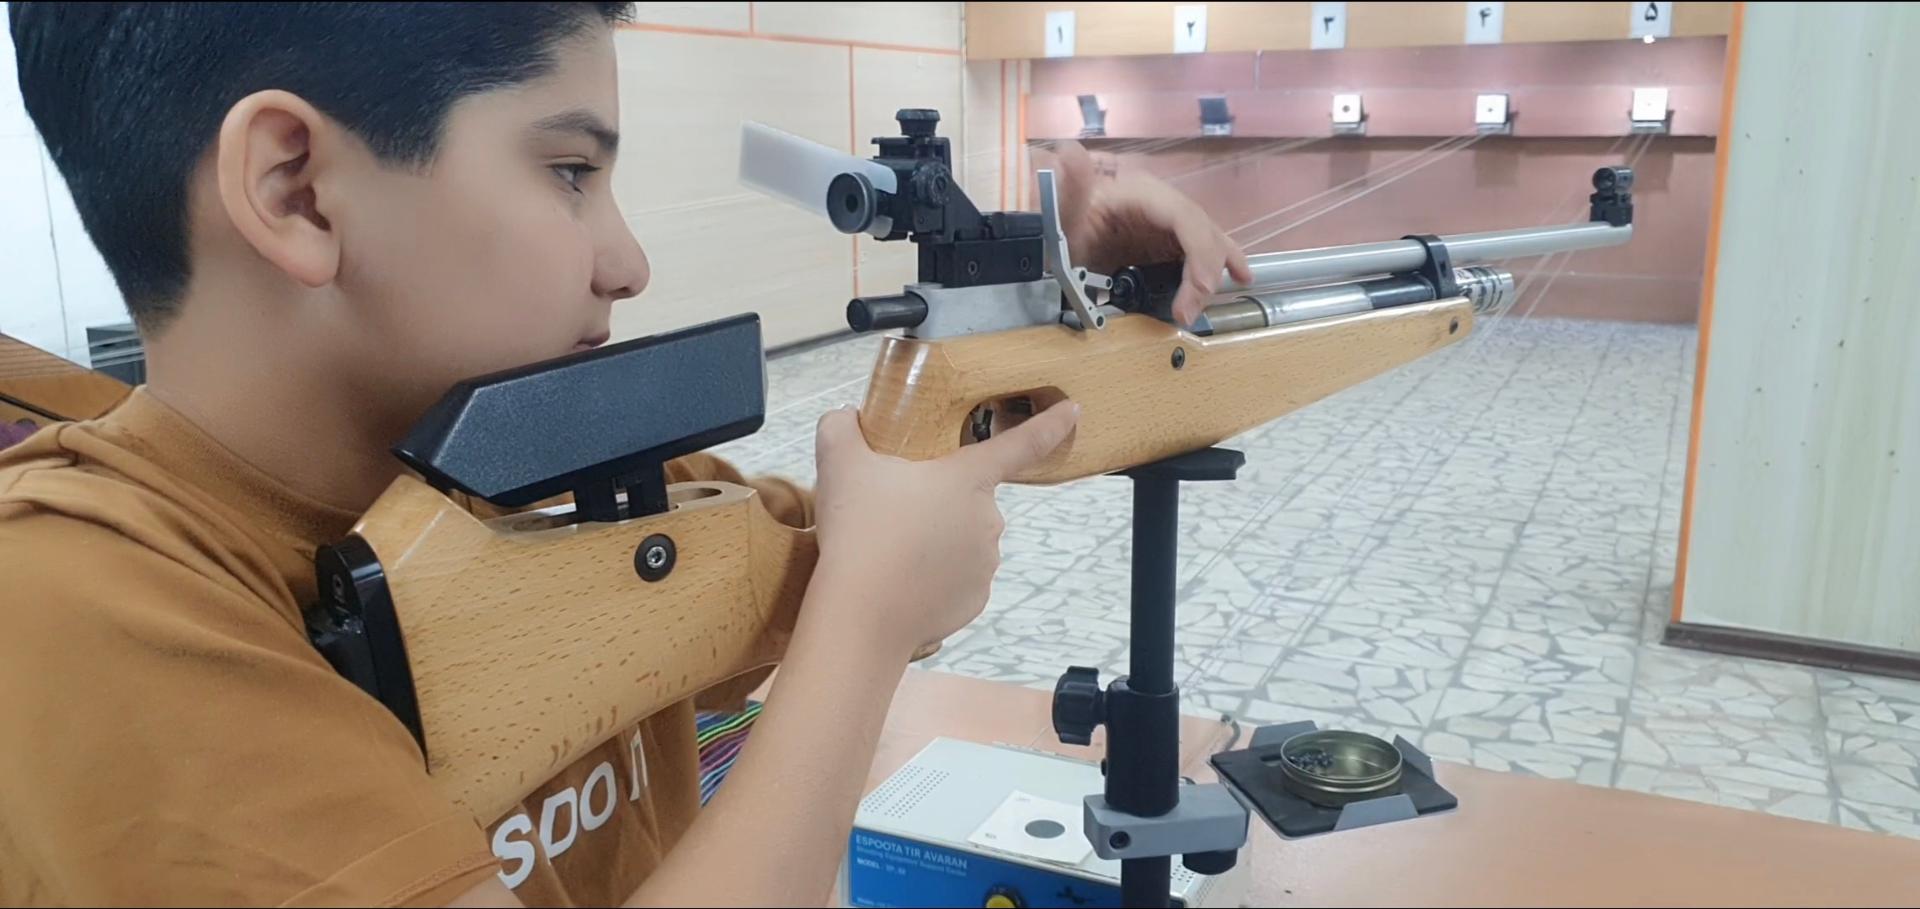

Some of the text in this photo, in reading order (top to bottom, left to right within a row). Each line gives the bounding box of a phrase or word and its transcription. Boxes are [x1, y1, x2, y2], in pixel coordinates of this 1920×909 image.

[1186, 20, 1196, 39] ۲
[856, 834, 903, 855] ESPOOTA
[905, 847, 920, 859] TIR
[923, 850, 968, 870] AVARAN
